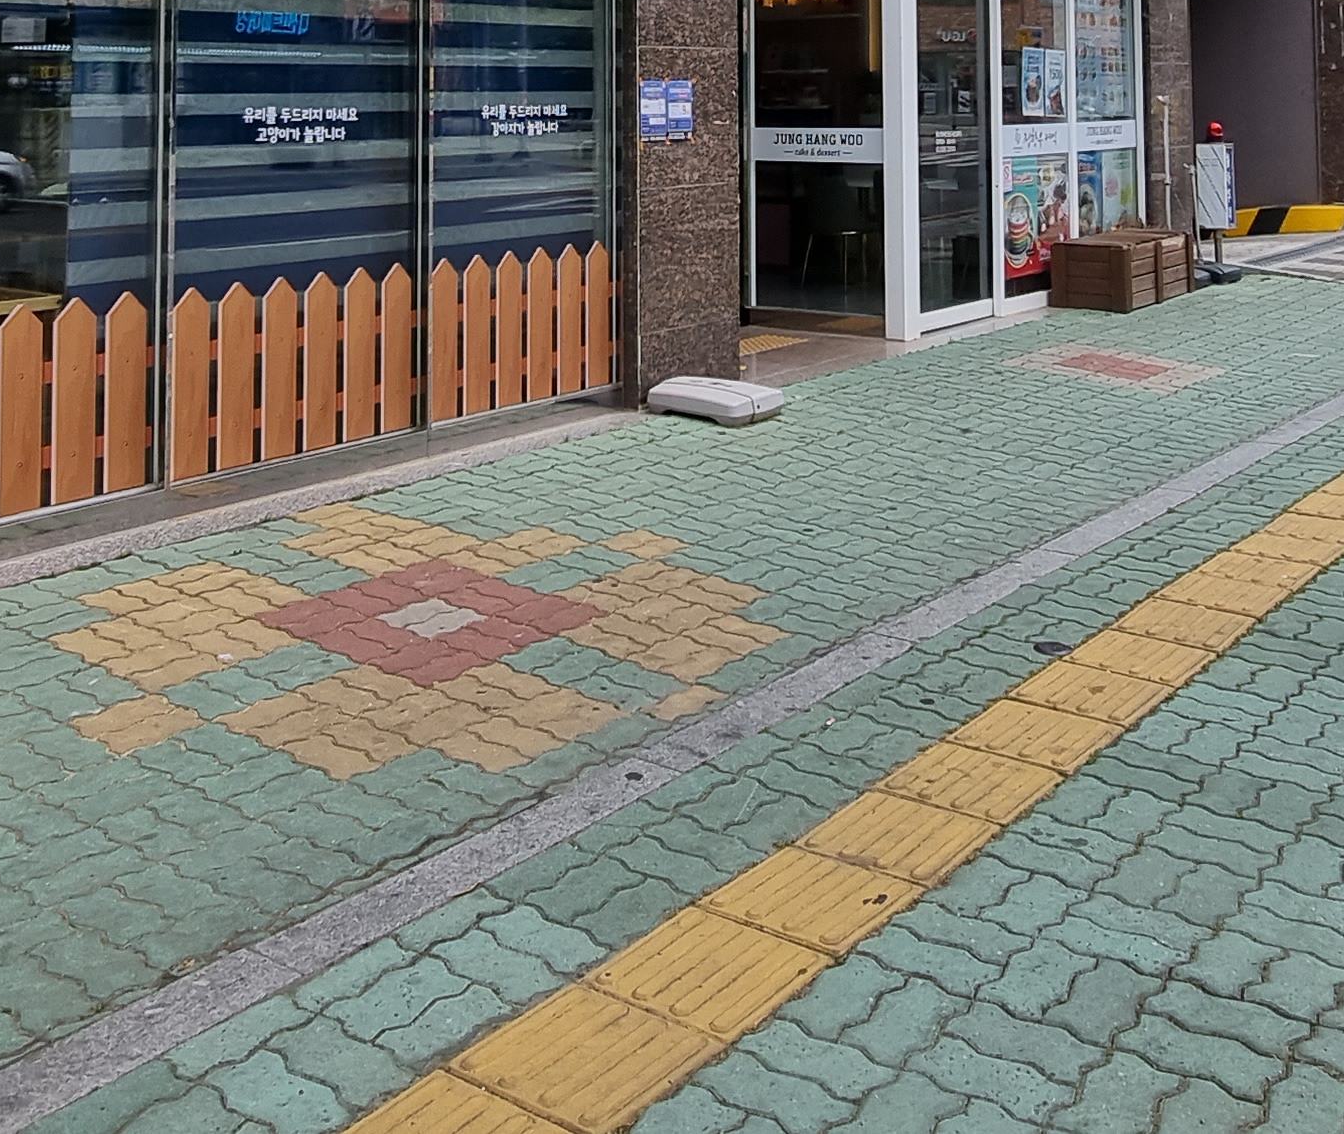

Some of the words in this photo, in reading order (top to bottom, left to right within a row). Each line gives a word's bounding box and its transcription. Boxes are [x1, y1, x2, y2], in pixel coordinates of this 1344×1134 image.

[243, 107, 277, 123] 유리를
[279, 107, 325, 122] 두드리지
[326, 106, 359, 122] 마세요
[481, 104, 507, 119] 유리를
[508, 104, 541, 118] 두드리지
[255, 126, 301, 144] 고양이가
[490, 120, 525, 137] 강아지가
[773, 133, 803, 145] JUNG
[805, 134, 836, 146] HANG
[840, 134, 863, 146] WOO
